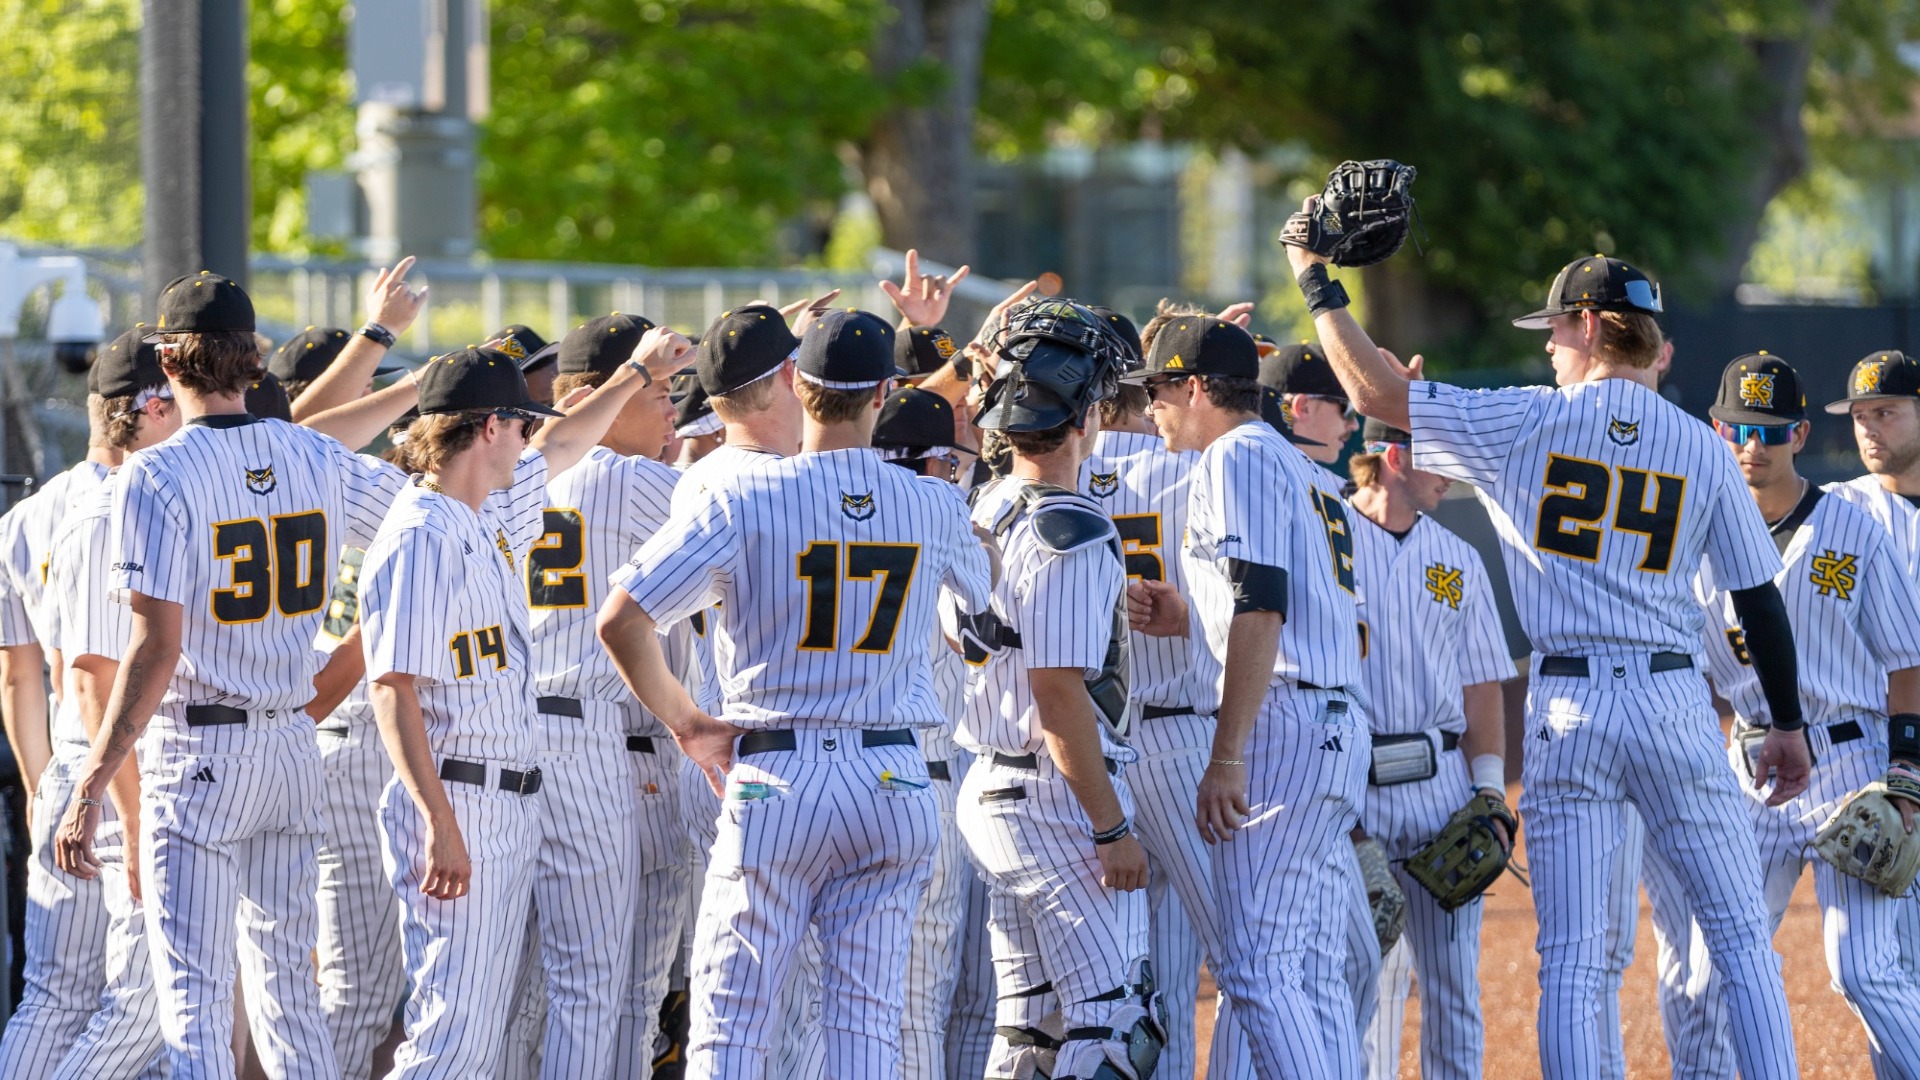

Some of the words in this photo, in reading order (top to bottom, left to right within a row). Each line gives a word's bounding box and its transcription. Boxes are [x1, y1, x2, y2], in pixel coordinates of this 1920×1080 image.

[210, 508, 329, 625] 30
[524, 508, 589, 609] 2
[1534, 452, 1687, 574] 24
[449, 623, 508, 679] 14
[796, 541, 921, 654] 17
